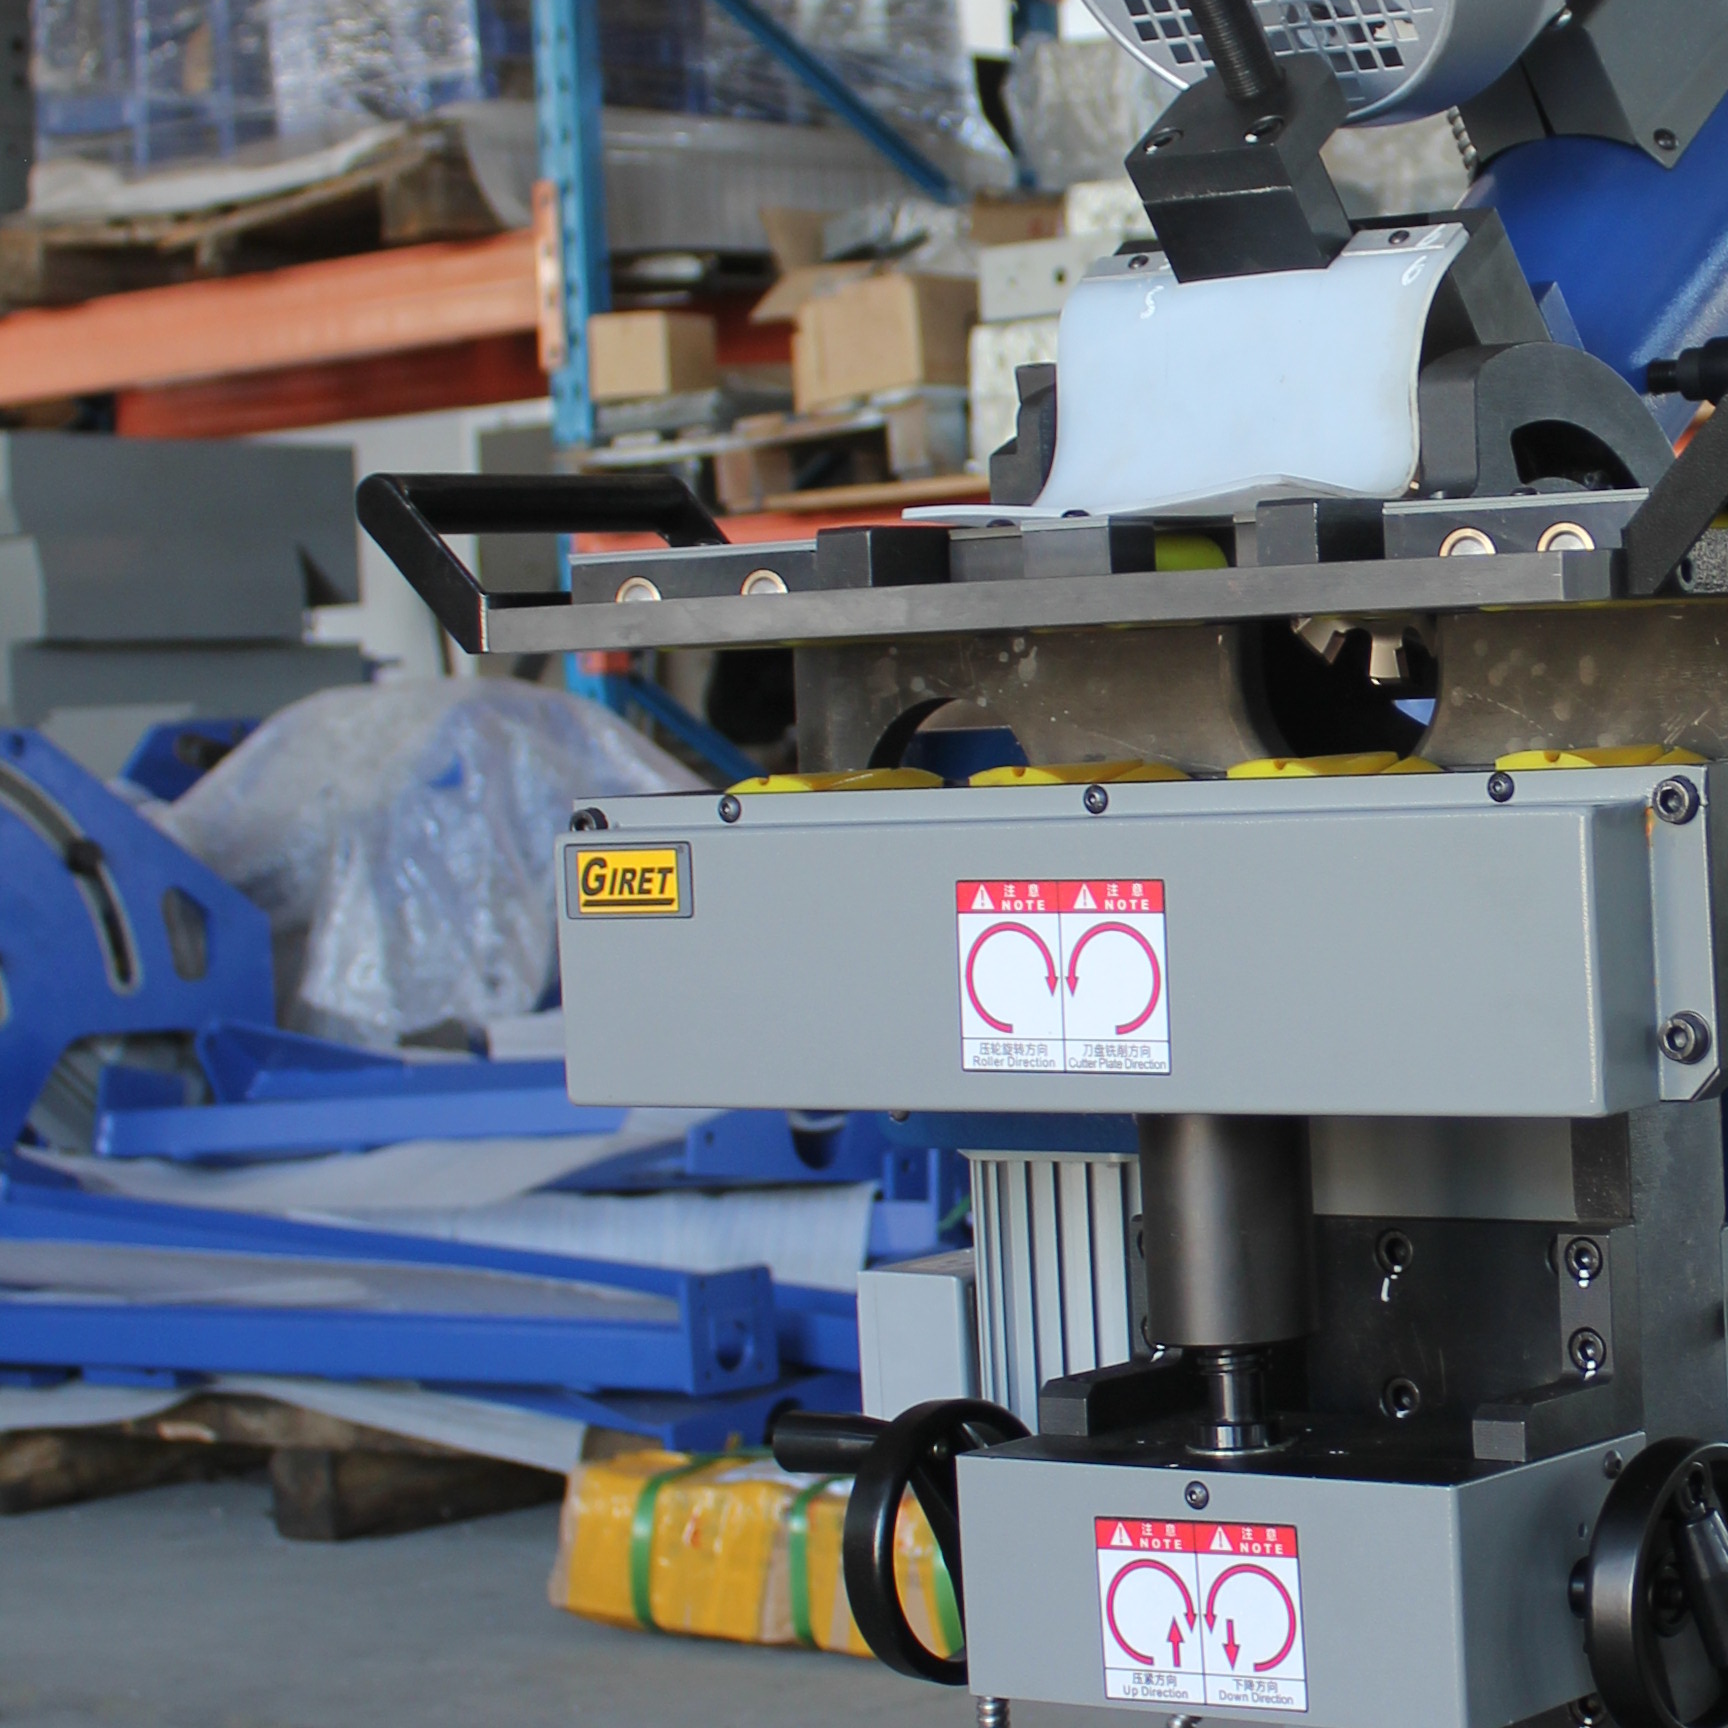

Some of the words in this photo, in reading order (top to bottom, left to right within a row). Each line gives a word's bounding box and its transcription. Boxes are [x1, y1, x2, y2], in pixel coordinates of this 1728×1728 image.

[582, 857, 675, 896] GIRET
[1004, 883, 1040, 897] 注意
[1107, 883, 1144, 897] 注意
[1001, 900, 1045, 911] NOTE
[1104, 899, 1150, 911] NOTE
[973, 1055, 1004, 1067] Roller
[1007, 1056, 1056, 1068] Direction
[1068, 1057, 1096, 1069] Cutter
[1099, 1058, 1122, 1069] Plate
[1125, 1058, 1167, 1070] Direction
[1142, 1522, 1177, 1537] 注意
[1241, 1526, 1278, 1541] 注意
[1139, 1538, 1183, 1550] NOTE
[1239, 1542, 1284, 1555] NOTE
[1132, 1672, 1178, 1687] 压紧方向
[1122, 1685, 1138, 1696] Up
[1141, 1686, 1189, 1699] Direction
[1218, 1690, 1249, 1702] Down
[1252, 1692, 1294, 1705] Direction
